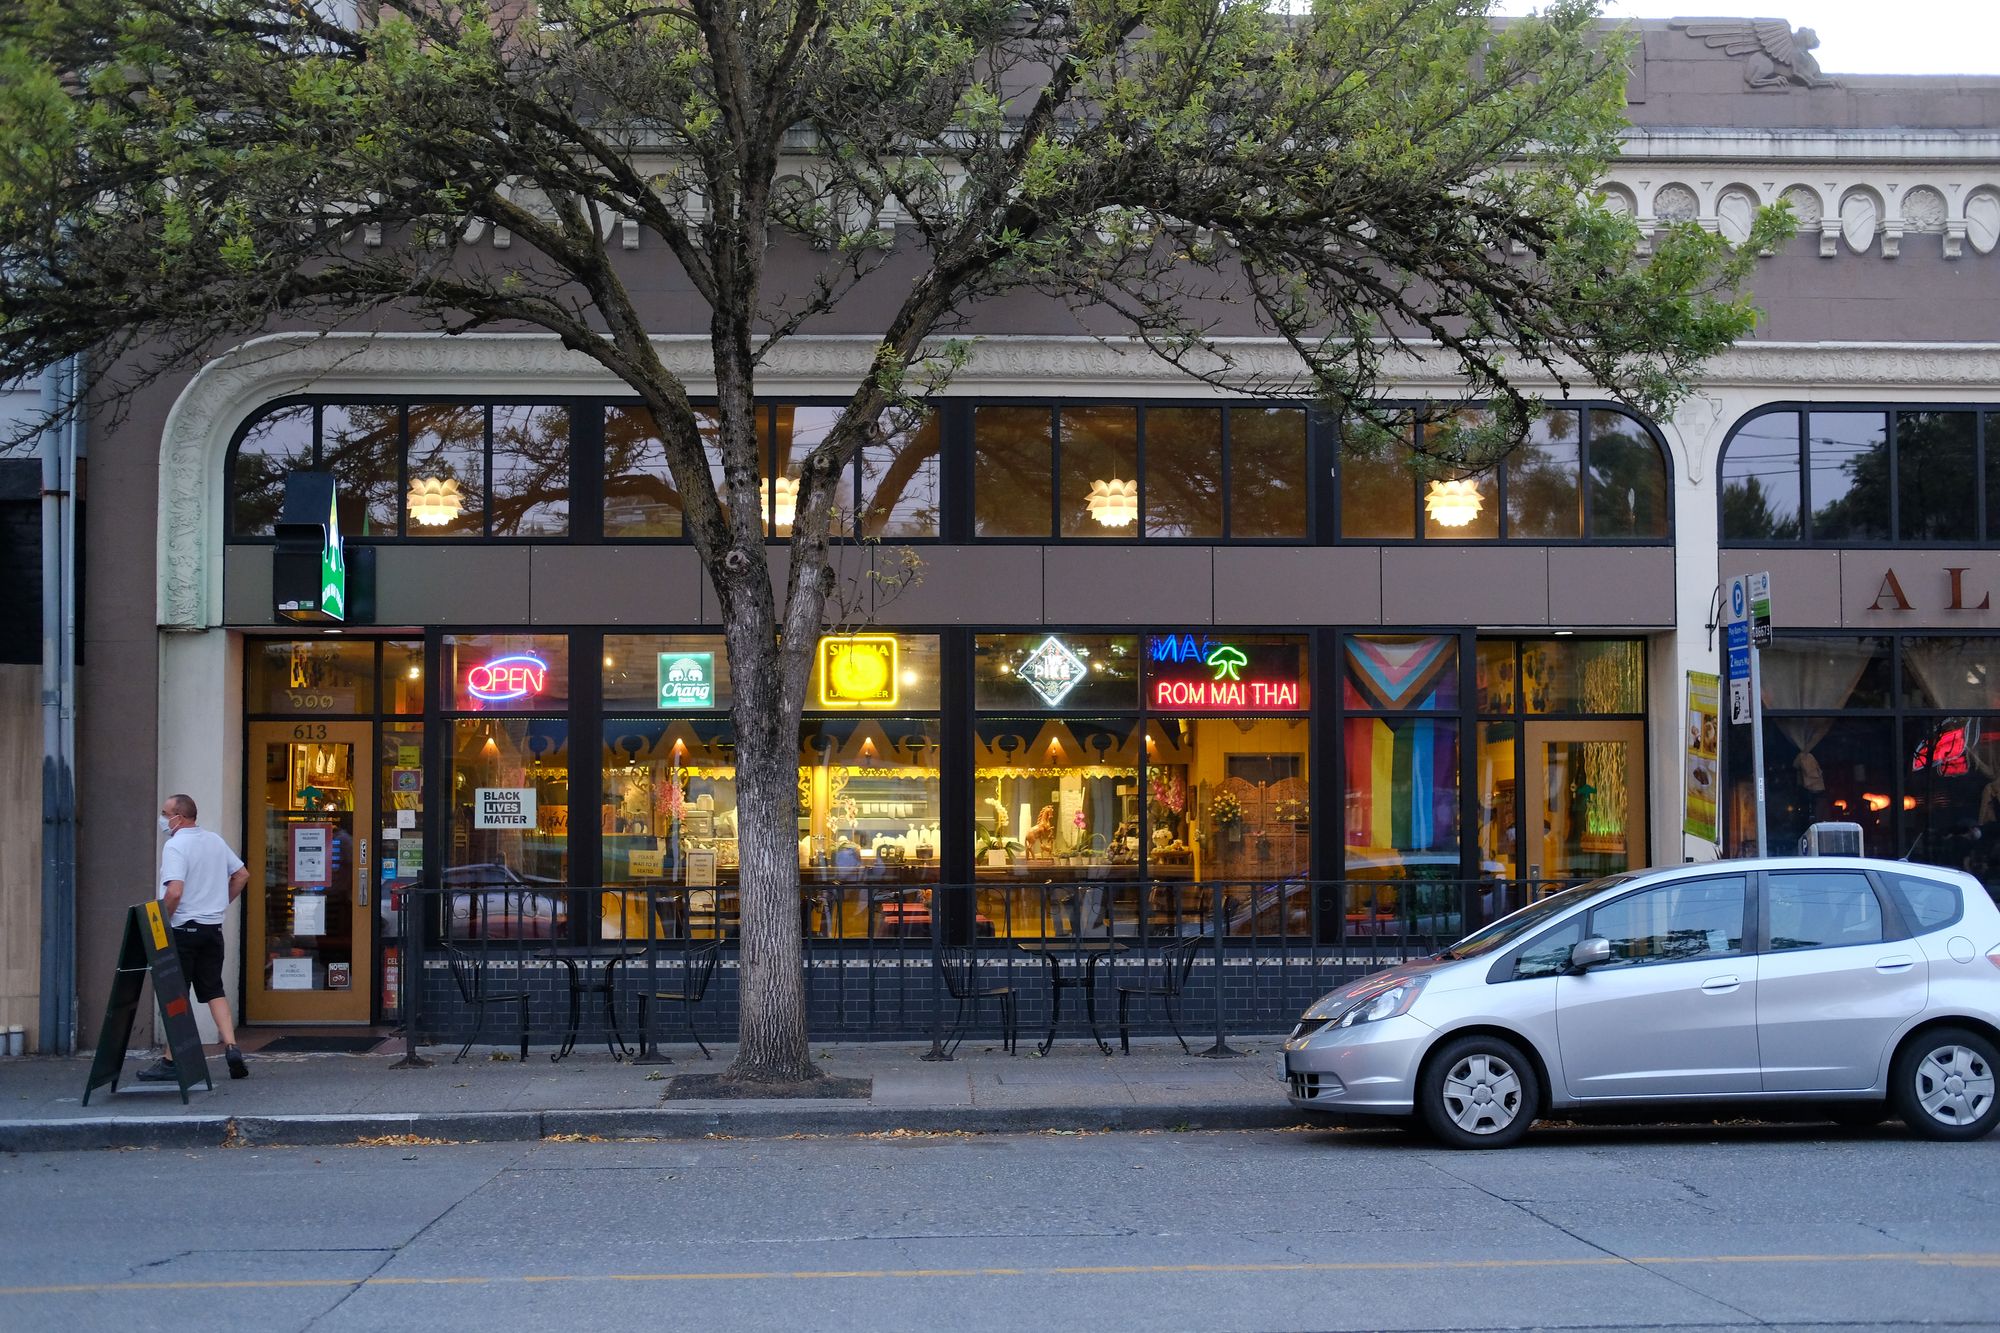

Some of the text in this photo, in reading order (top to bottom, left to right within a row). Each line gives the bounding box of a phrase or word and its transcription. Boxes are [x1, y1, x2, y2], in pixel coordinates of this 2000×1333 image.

[468, 666, 545, 692] OPEN
[661, 682, 710, 700] Chang
[1157, 682, 1297, 705] ROM MAI THAI
[294, 724, 328, 740] 613
[483, 791, 521, 801] BLACK
[485, 803, 519, 813] LIVES
[483, 815, 527, 825] MATTER
